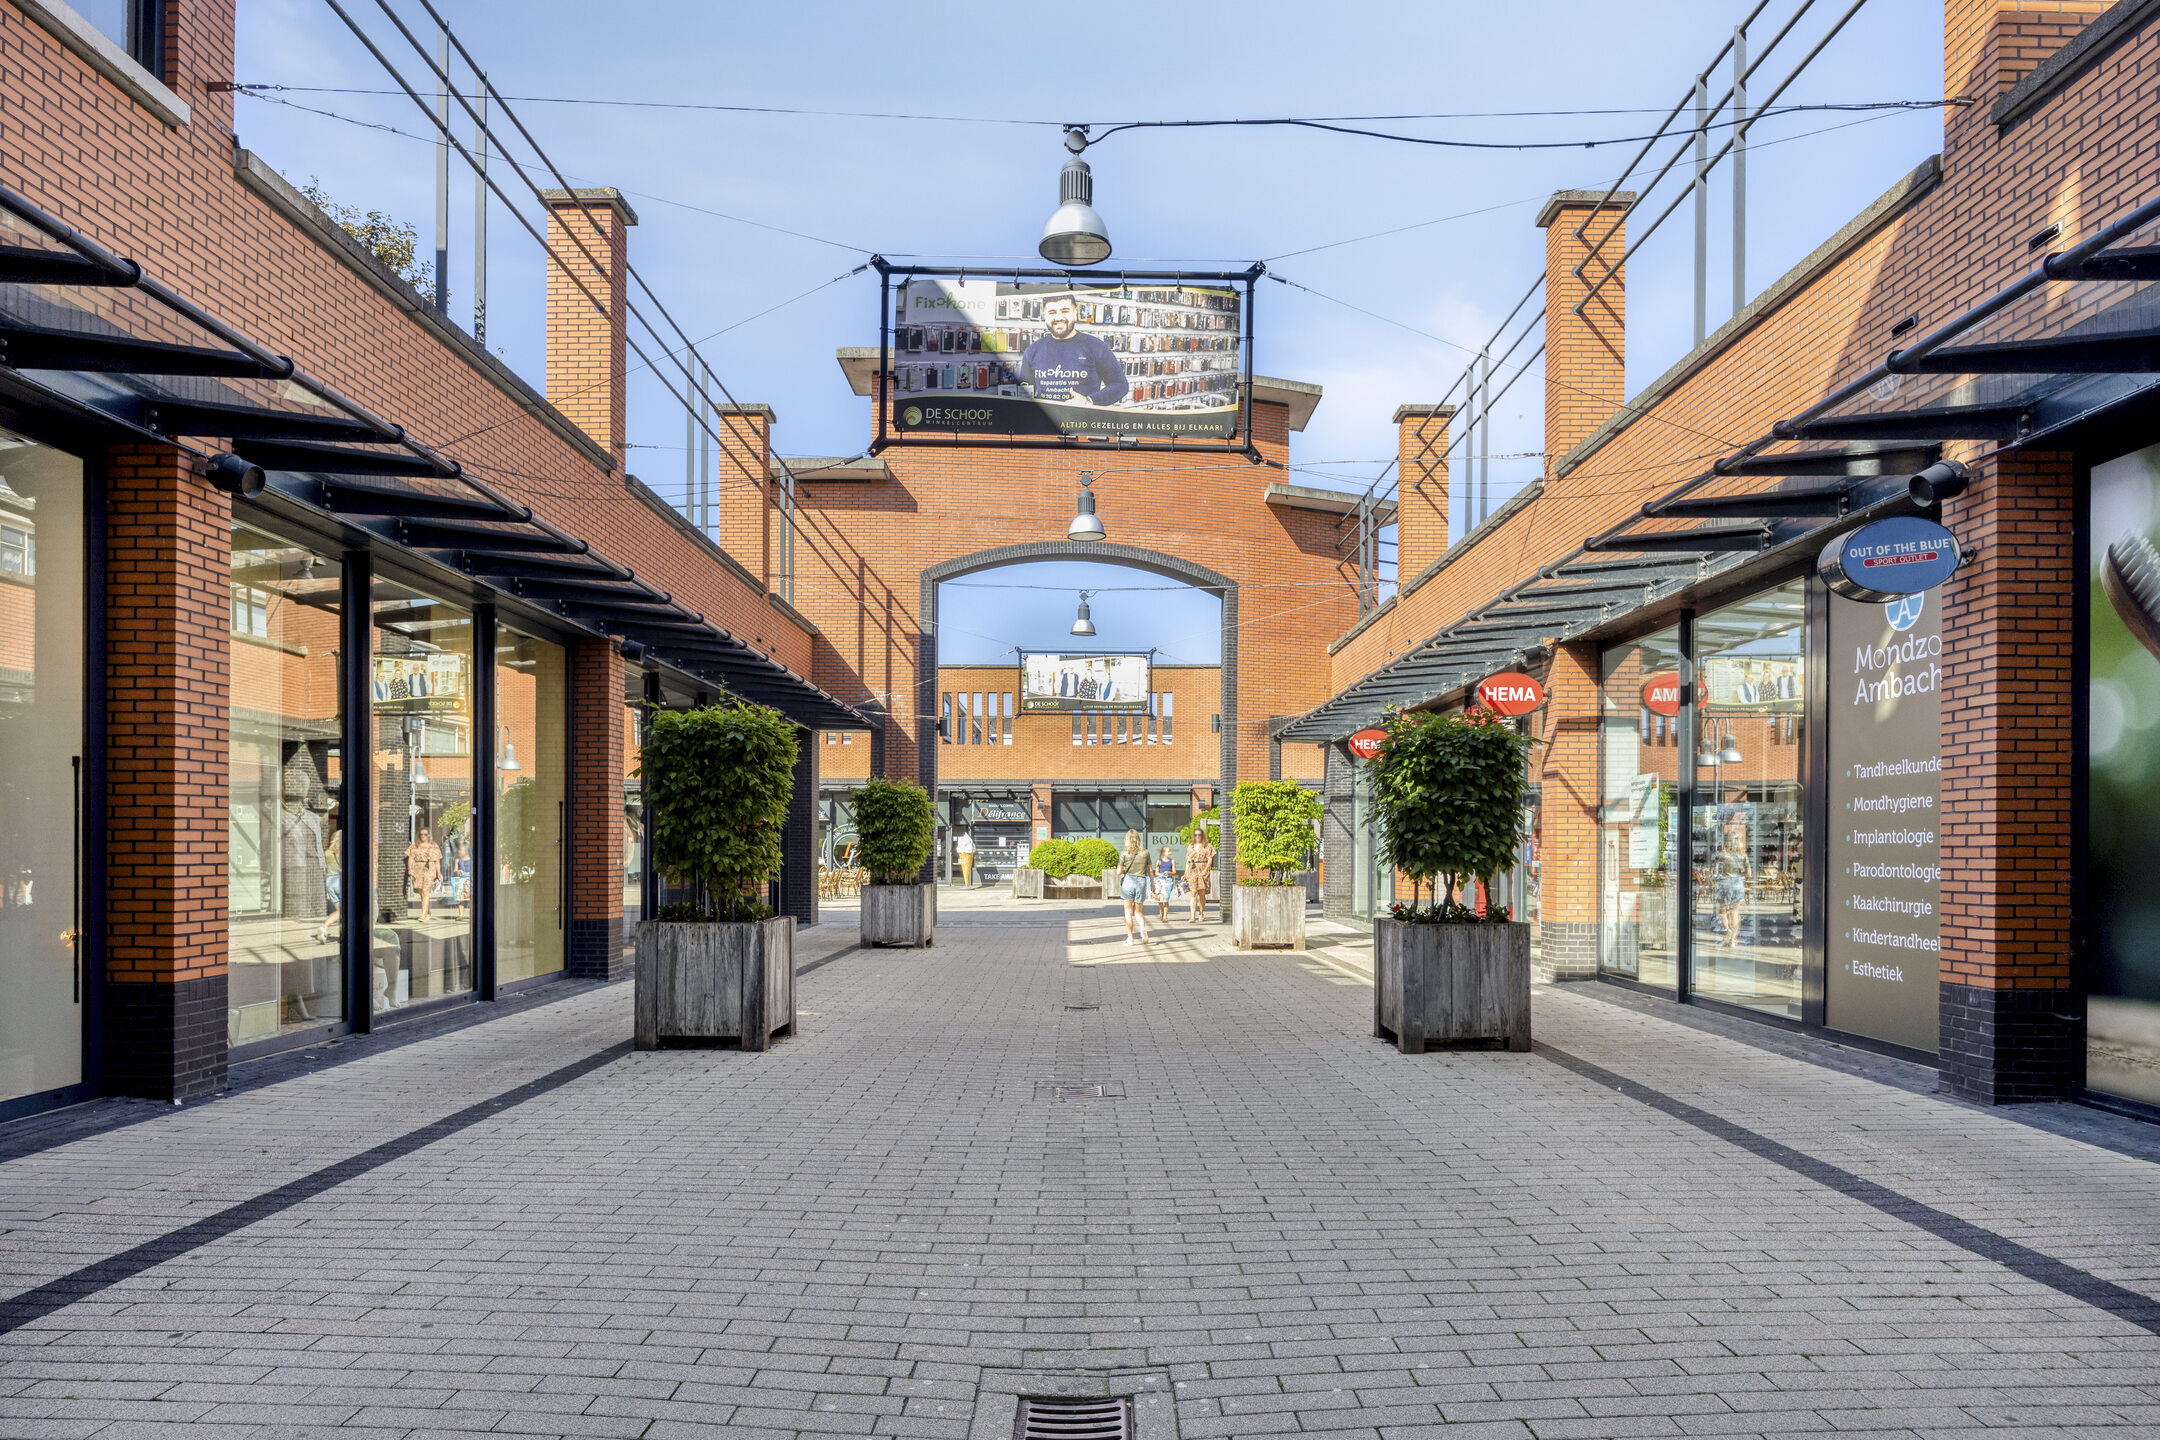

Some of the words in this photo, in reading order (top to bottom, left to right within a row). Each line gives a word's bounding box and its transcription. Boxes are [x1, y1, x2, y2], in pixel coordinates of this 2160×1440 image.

[926, 408, 942, 419] DE
[944, 408, 993, 420] SCHOOF
[1060, 421, 1088, 429] ALTIJD
[1090, 422, 1130, 430] GEZELLIG
[1132, 422, 1143, 430] EN
[1146, 423, 1171, 431] ALLES
[1849, 546, 1873, 558] OUT
[1876, 545, 1892, 556] OF
[1893, 542, 1917, 554] THE
[1920, 538, 1950, 551] BLUE
[1873, 557, 1898, 566] SPORT
[1900, 553, 1928, 563] OUTLET
[1854, 633, 1942, 674] Mondzo
[1485, 686, 1536, 702] HEMA
[1354, 738, 1383, 750] HEM
[1853, 756, 1941, 779] Tandheelkunde
[1853, 793, 1933, 813] Mondhygiene
[1853, 828, 1934, 848] Implantologie
[1853, 862, 1941, 883] Parodontologie
[1853, 894, 1932, 918] Kaakchirurgie
[1852, 960, 1904, 982] Esthetiek
